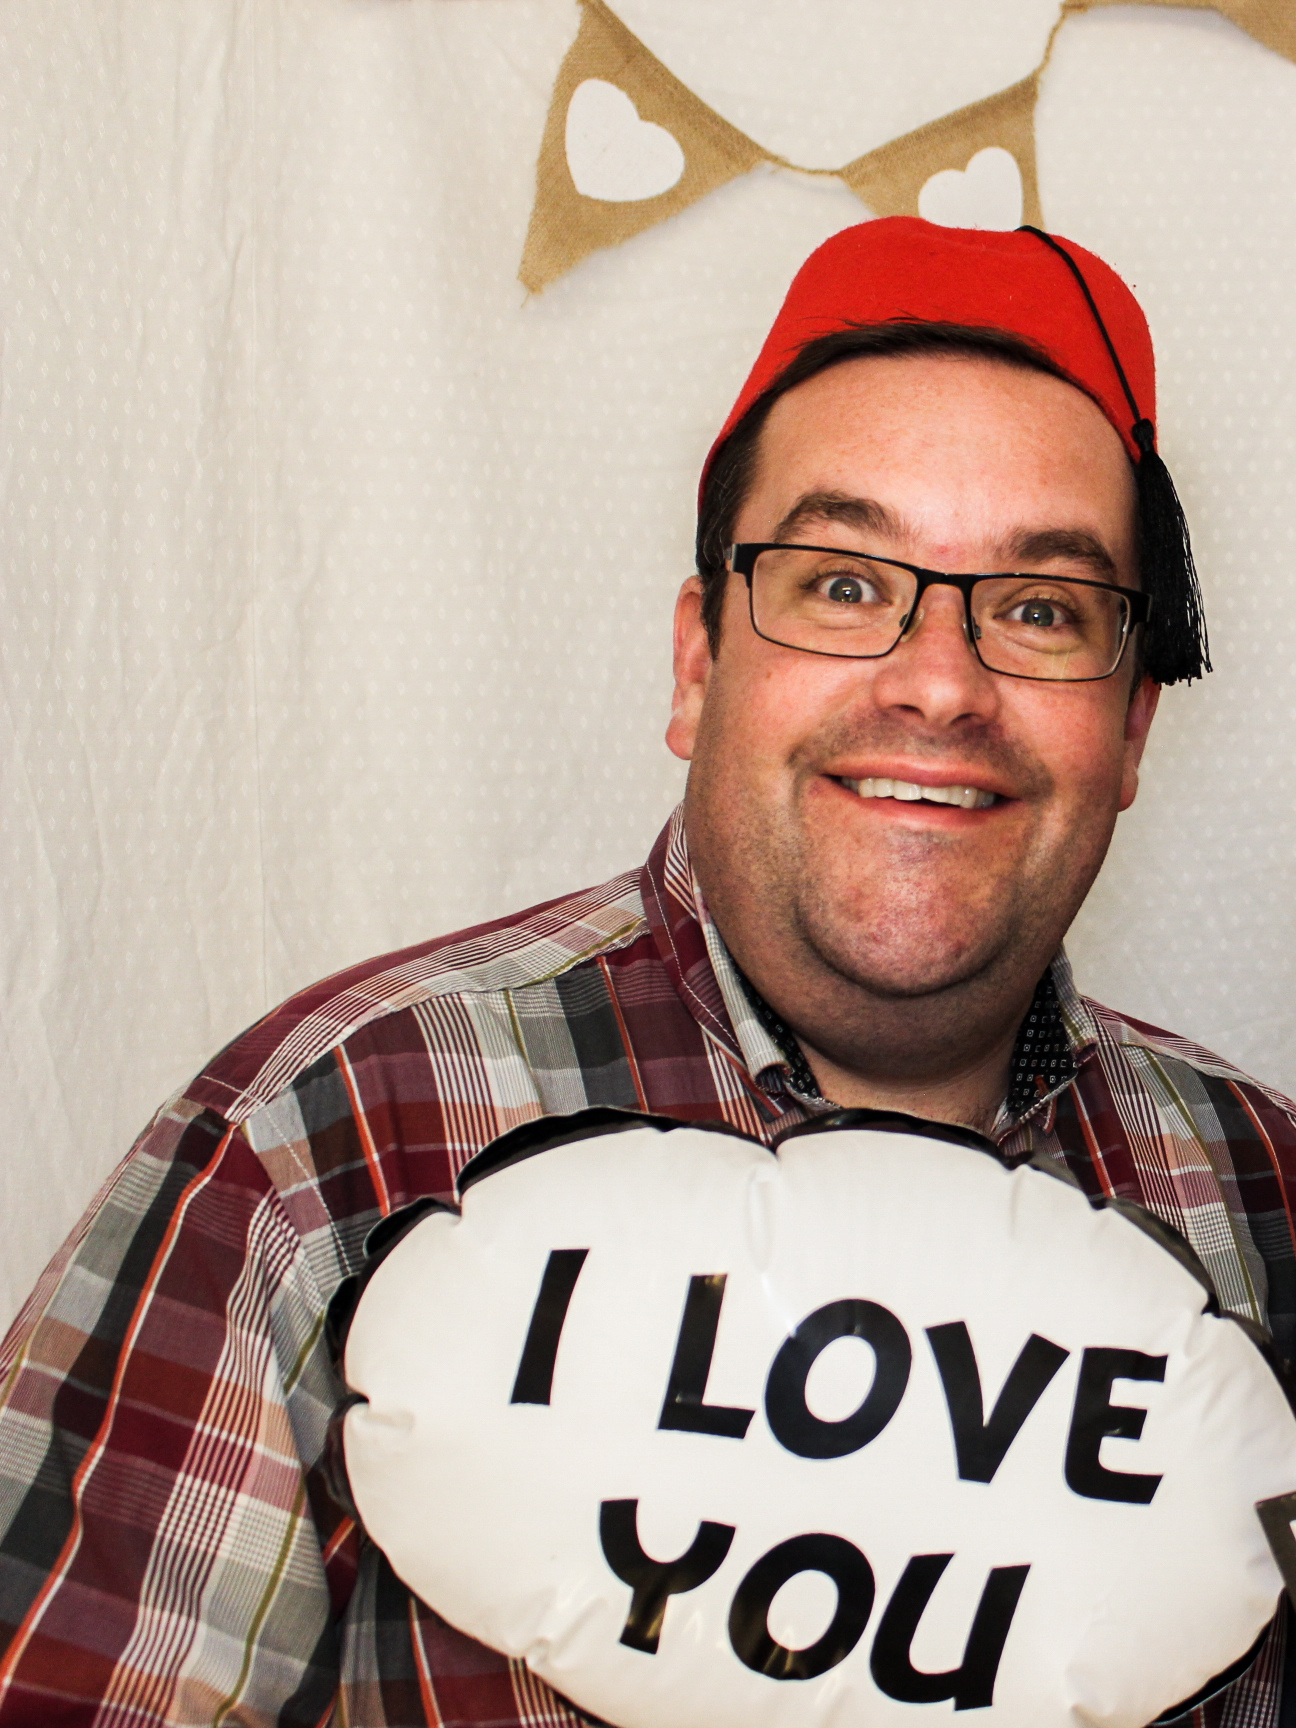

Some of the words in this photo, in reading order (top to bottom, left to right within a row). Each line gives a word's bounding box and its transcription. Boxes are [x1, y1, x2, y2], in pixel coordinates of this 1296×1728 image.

[510, 1248, 590, 1405] I
[657, 1273, 1169, 1504] LOVE
[599, 1498, 1032, 1711] YOU
